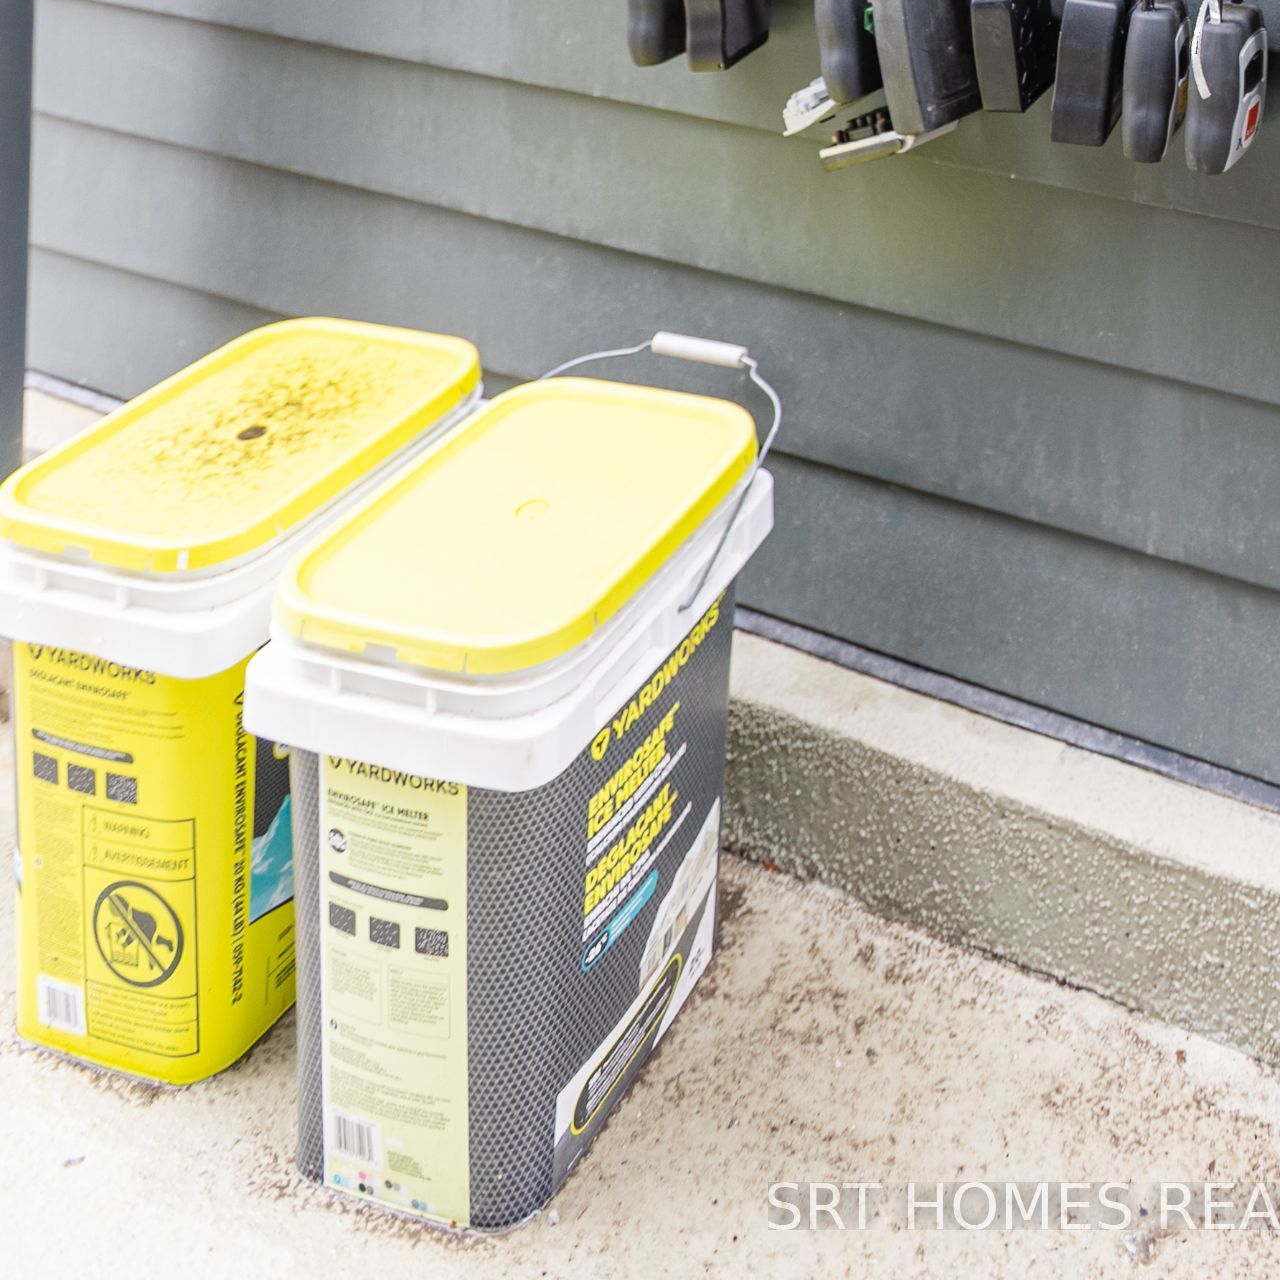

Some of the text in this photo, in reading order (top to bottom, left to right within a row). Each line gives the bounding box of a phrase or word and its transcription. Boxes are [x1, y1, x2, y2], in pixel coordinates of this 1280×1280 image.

[47, 644, 157, 686] YARDWORKS
[612, 598, 721, 740] YARDWORKS
[344, 757, 461, 797] YARDWORKS
[587, 739, 667, 840] ICE MELTER
[382, 804, 394, 815] ICE
[397, 806, 430, 821] MELTER
